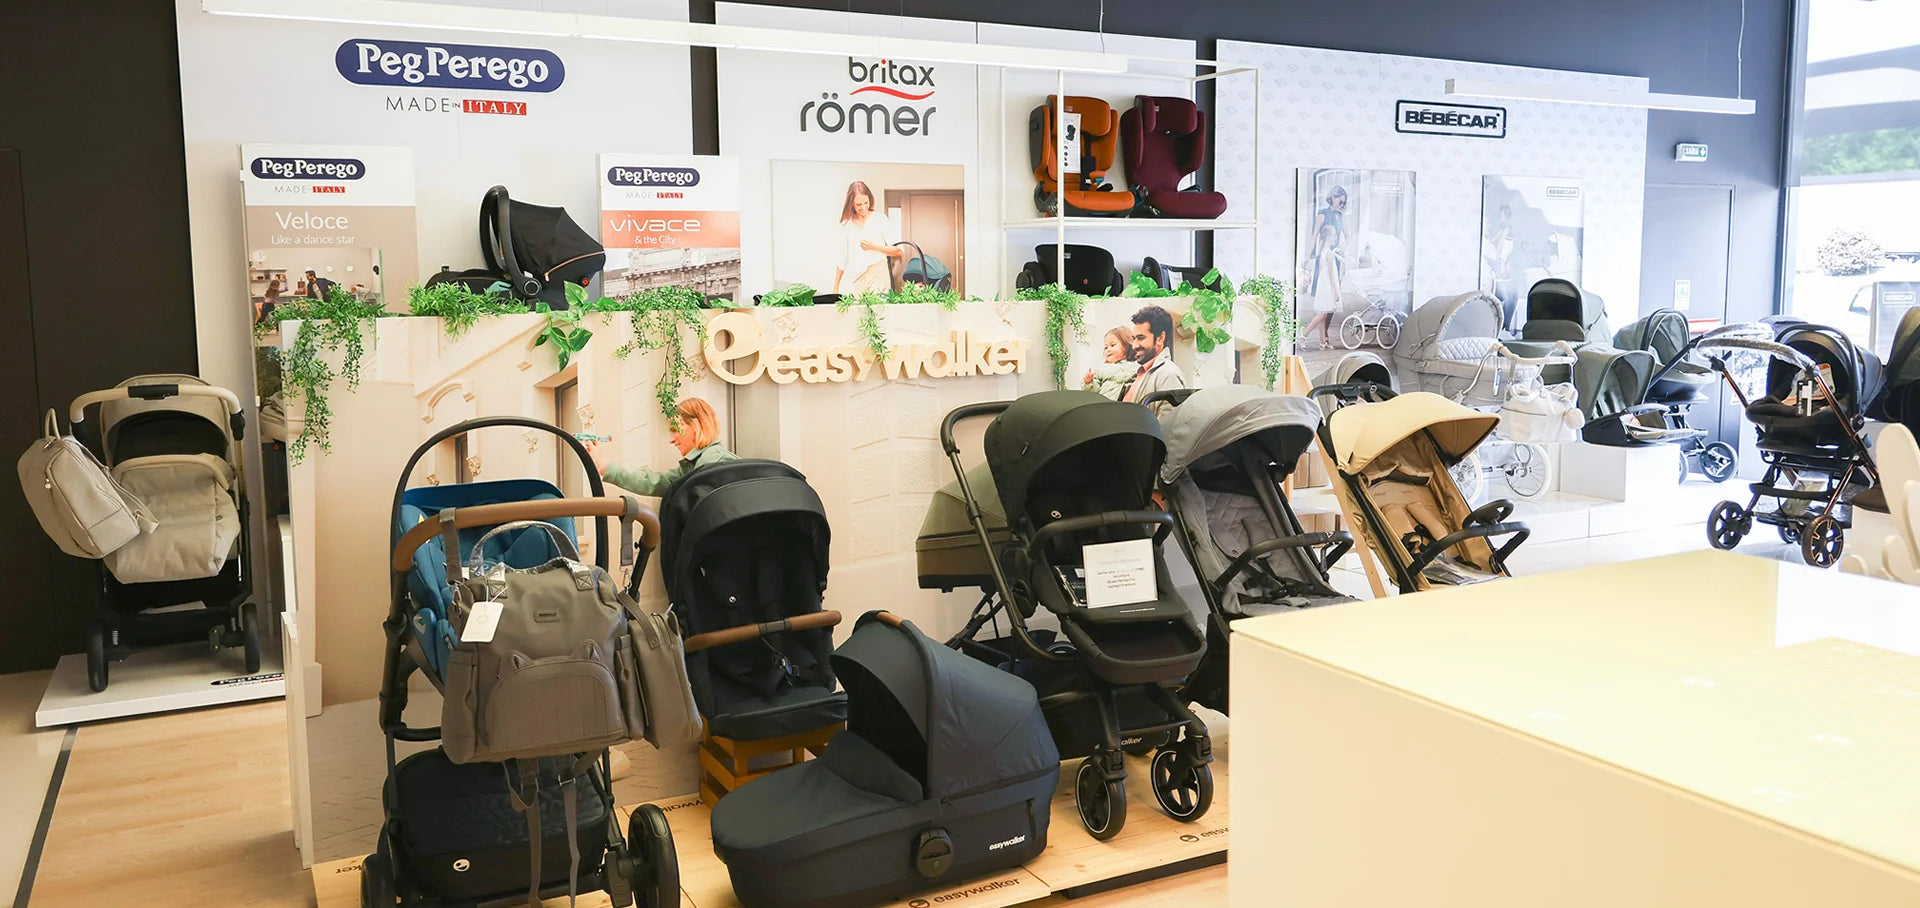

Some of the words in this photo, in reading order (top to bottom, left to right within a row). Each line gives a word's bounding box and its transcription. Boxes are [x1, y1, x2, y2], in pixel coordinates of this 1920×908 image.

[848, 56, 935, 87] britax
[386, 96, 450, 113] MADE
[467, 100, 525, 115] ITALY
[800, 92, 937, 136] römer
[275, 211, 349, 230] Veloce
[609, 214, 701, 232] vivace
[271, 235, 292, 245] Like
[294, 237, 300, 245] a
[303, 235, 333, 245] dance
[336, 235, 356, 245] star
[634, 235, 642, 245] &
[643, 235, 657, 245] the
[658, 235, 677, 245] City
[766, 330, 1031, 384] easywalker
[989, 835, 1026, 851] easywalker
[933, 878, 1020, 903] easywalker
